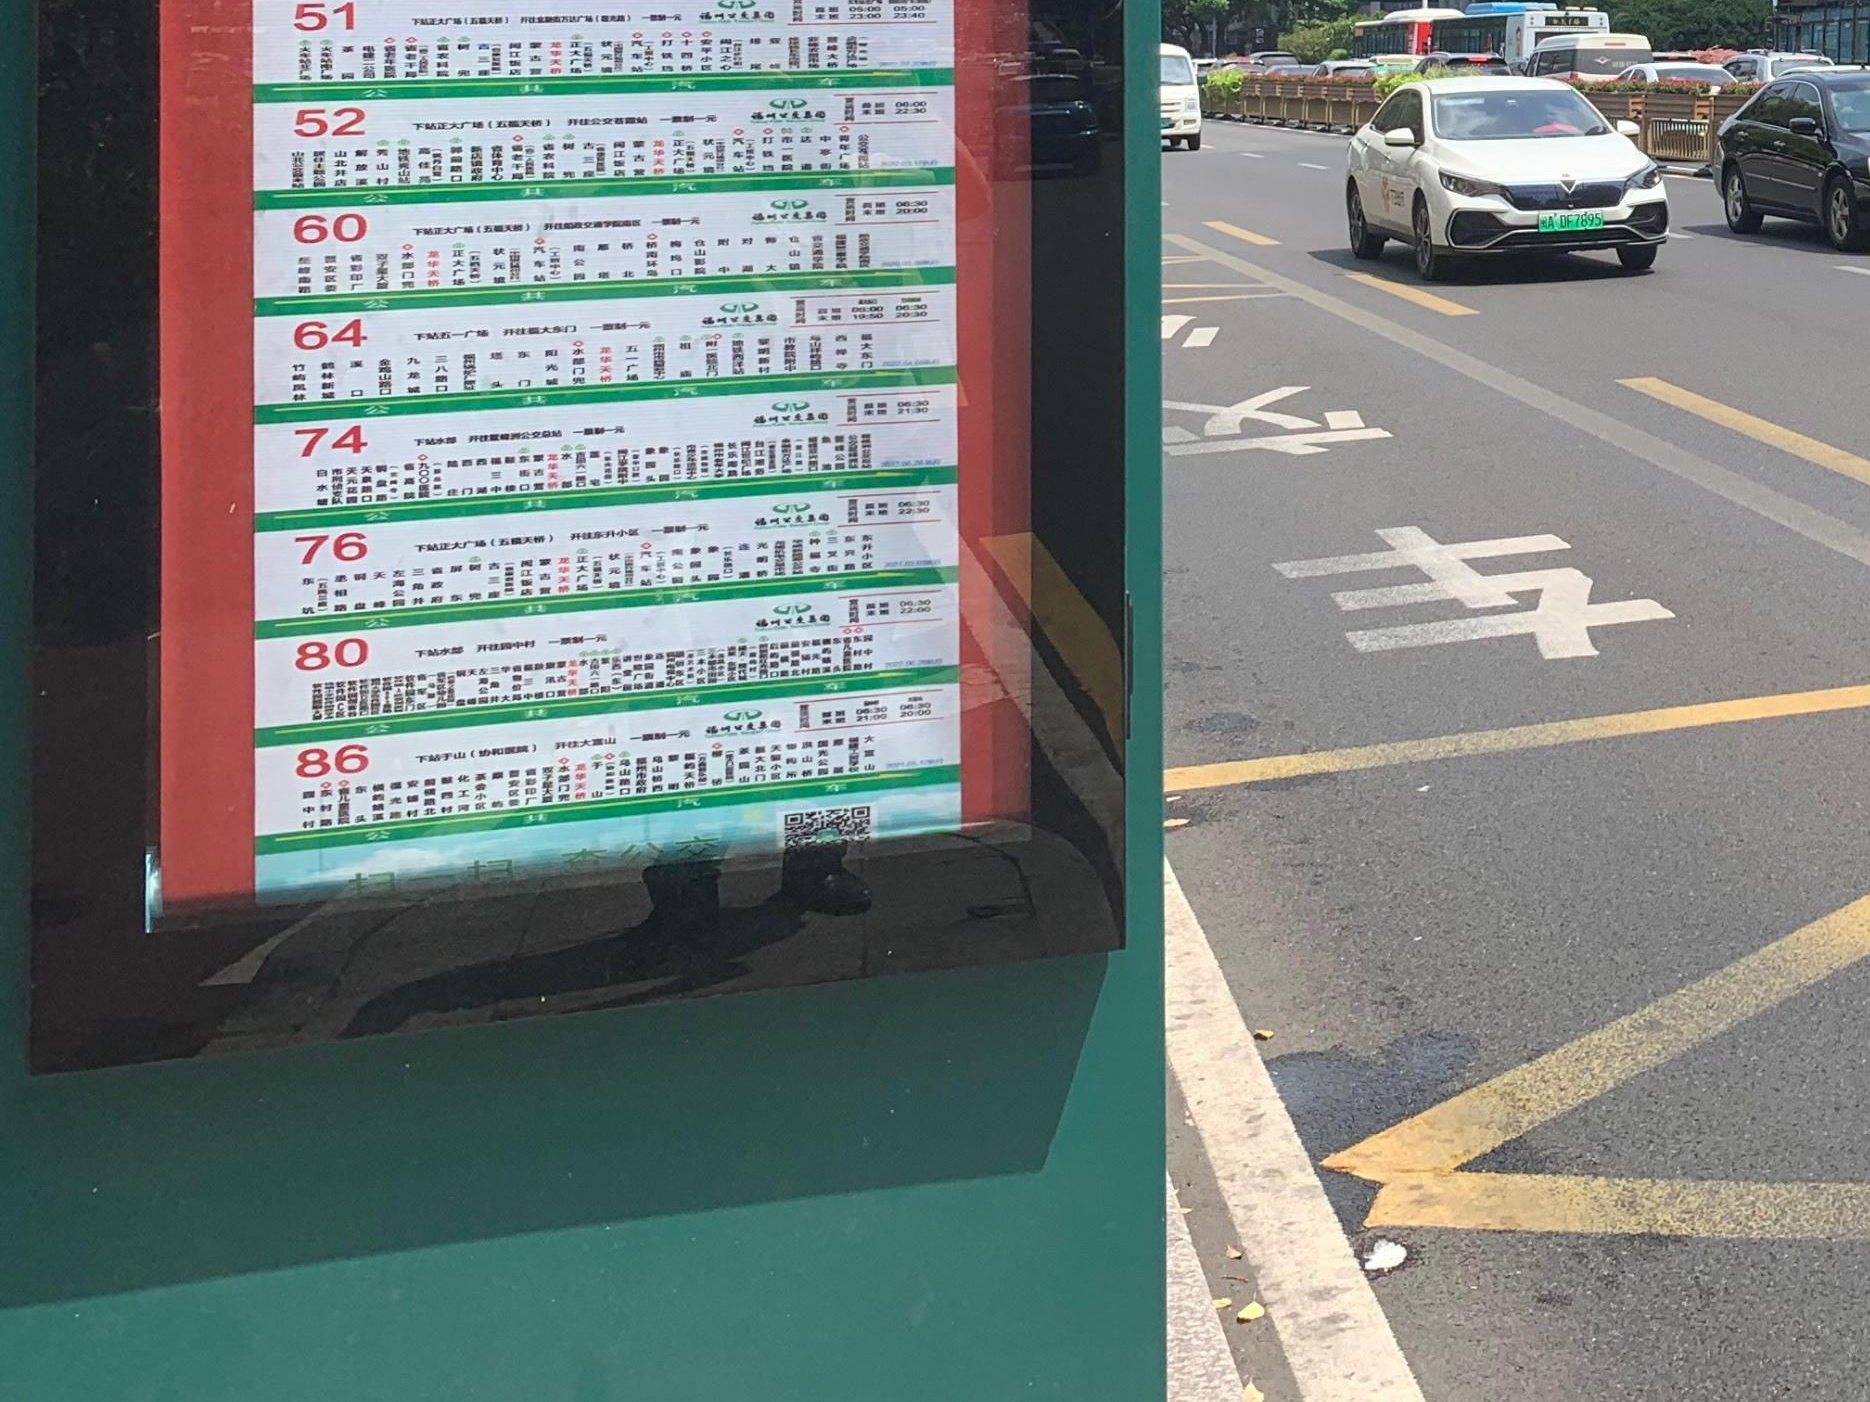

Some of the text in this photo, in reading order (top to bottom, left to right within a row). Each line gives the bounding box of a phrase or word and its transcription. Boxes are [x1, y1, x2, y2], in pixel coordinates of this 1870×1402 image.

[293, 2, 354, 31] 51
[894, 106, 926, 114] 22:30
[895, 100, 927, 108] 06:00
[293, 107, 365, 137] 52
[1560, 213, 1602, 228] DF7895
[293, 212, 367, 244] 60
[850, 303, 927, 313] 05:00 06:30
[852, 309, 927, 320] 19:50 20:30
[293, 318, 367, 351] 64
[413, 329, 488, 341] 下站五一广场
[502, 325, 576, 336] 开往福大东门
[599, 346, 612, 384] 龙华天桥
[897, 400, 929, 408] 06:30
[897, 405, 928, 414] 21:30
[294, 424, 368, 457] 74
[413, 436, 457, 446] 下站水部
[898, 499, 929, 507] 06:30
[898, 505, 929, 515] 22:30
[570, 528, 639, 541] 开往东升小区
[294, 531, 367, 565] 76
[557, 557, 570, 595] 龙华天桥
[899, 598, 931, 608] 06:30
[899, 604, 931, 614] 22:00
[294, 637, 368, 672] 80
[414, 646, 464, 658] 下站水部
[476, 639, 535, 652] 开往园中村
[855, 702, 931, 715] 06:30 06:30
[856, 708, 931, 722] 21:00 20:00
[554, 736, 616, 750] 开往大富山
[295, 742, 369, 779] 86
[574, 763, 587, 802] 龙华天桥
